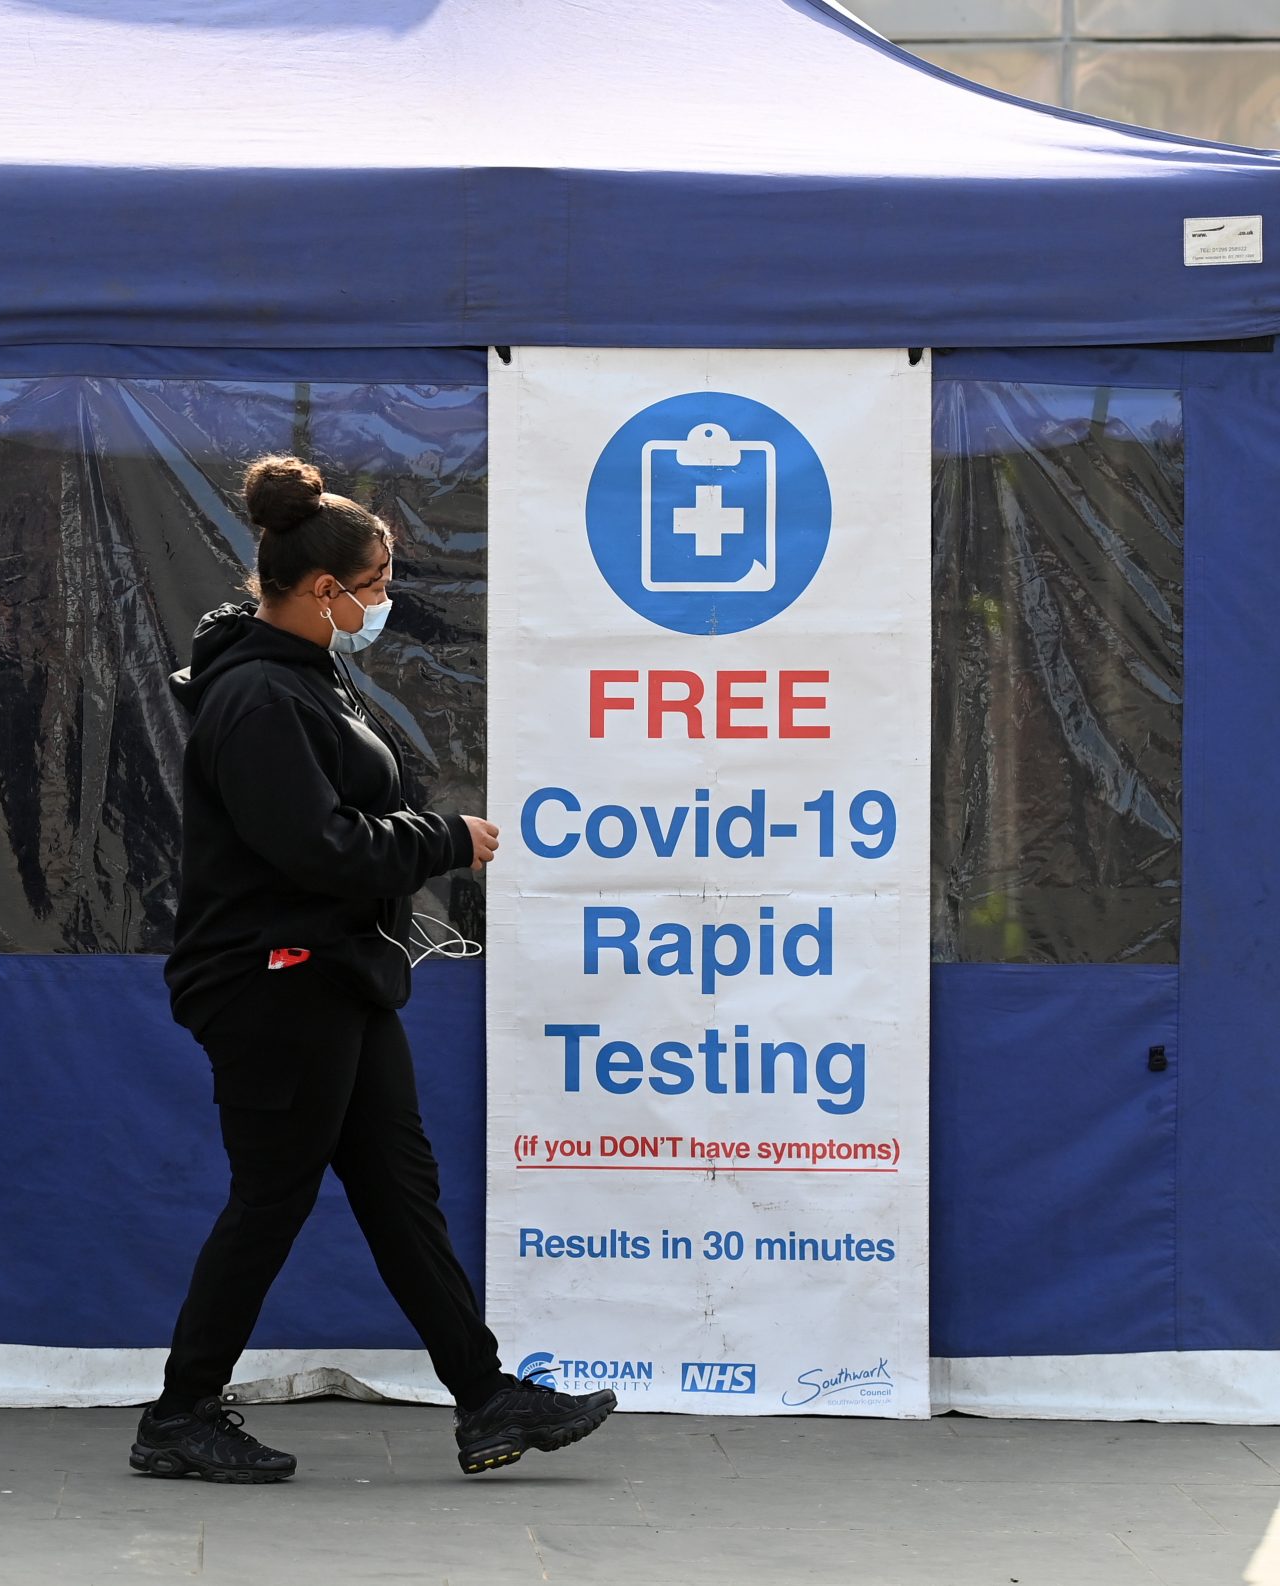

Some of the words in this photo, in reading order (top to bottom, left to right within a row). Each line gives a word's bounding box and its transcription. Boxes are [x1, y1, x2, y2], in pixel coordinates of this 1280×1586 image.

[589, 669, 831, 739] FREE
[520, 786, 897, 860] Covid-19
[583, 906, 834, 995] Rapid
[544, 1023, 866, 1115] Testing
[514, 1135, 538, 1162] (if
[545, 1139, 591, 1162] you
[600, 1135, 683, 1158] DON'T
[690, 1137, 751, 1159] have
[757, 1138, 900, 1165] symptoms)
[519, 1227, 651, 1260] Results
[662, 1229, 692, 1260] in
[703, 1230, 745, 1261] 30
[755, 1230, 896, 1262] minutes
[558, 1360, 653, 1380] TROJAN
[563, 1380, 653, 1392] SECURITY
[683, 1364, 754, 1393] NHS
[782, 1357, 891, 1407] Southwark
[859, 1388, 892, 1397] Council
